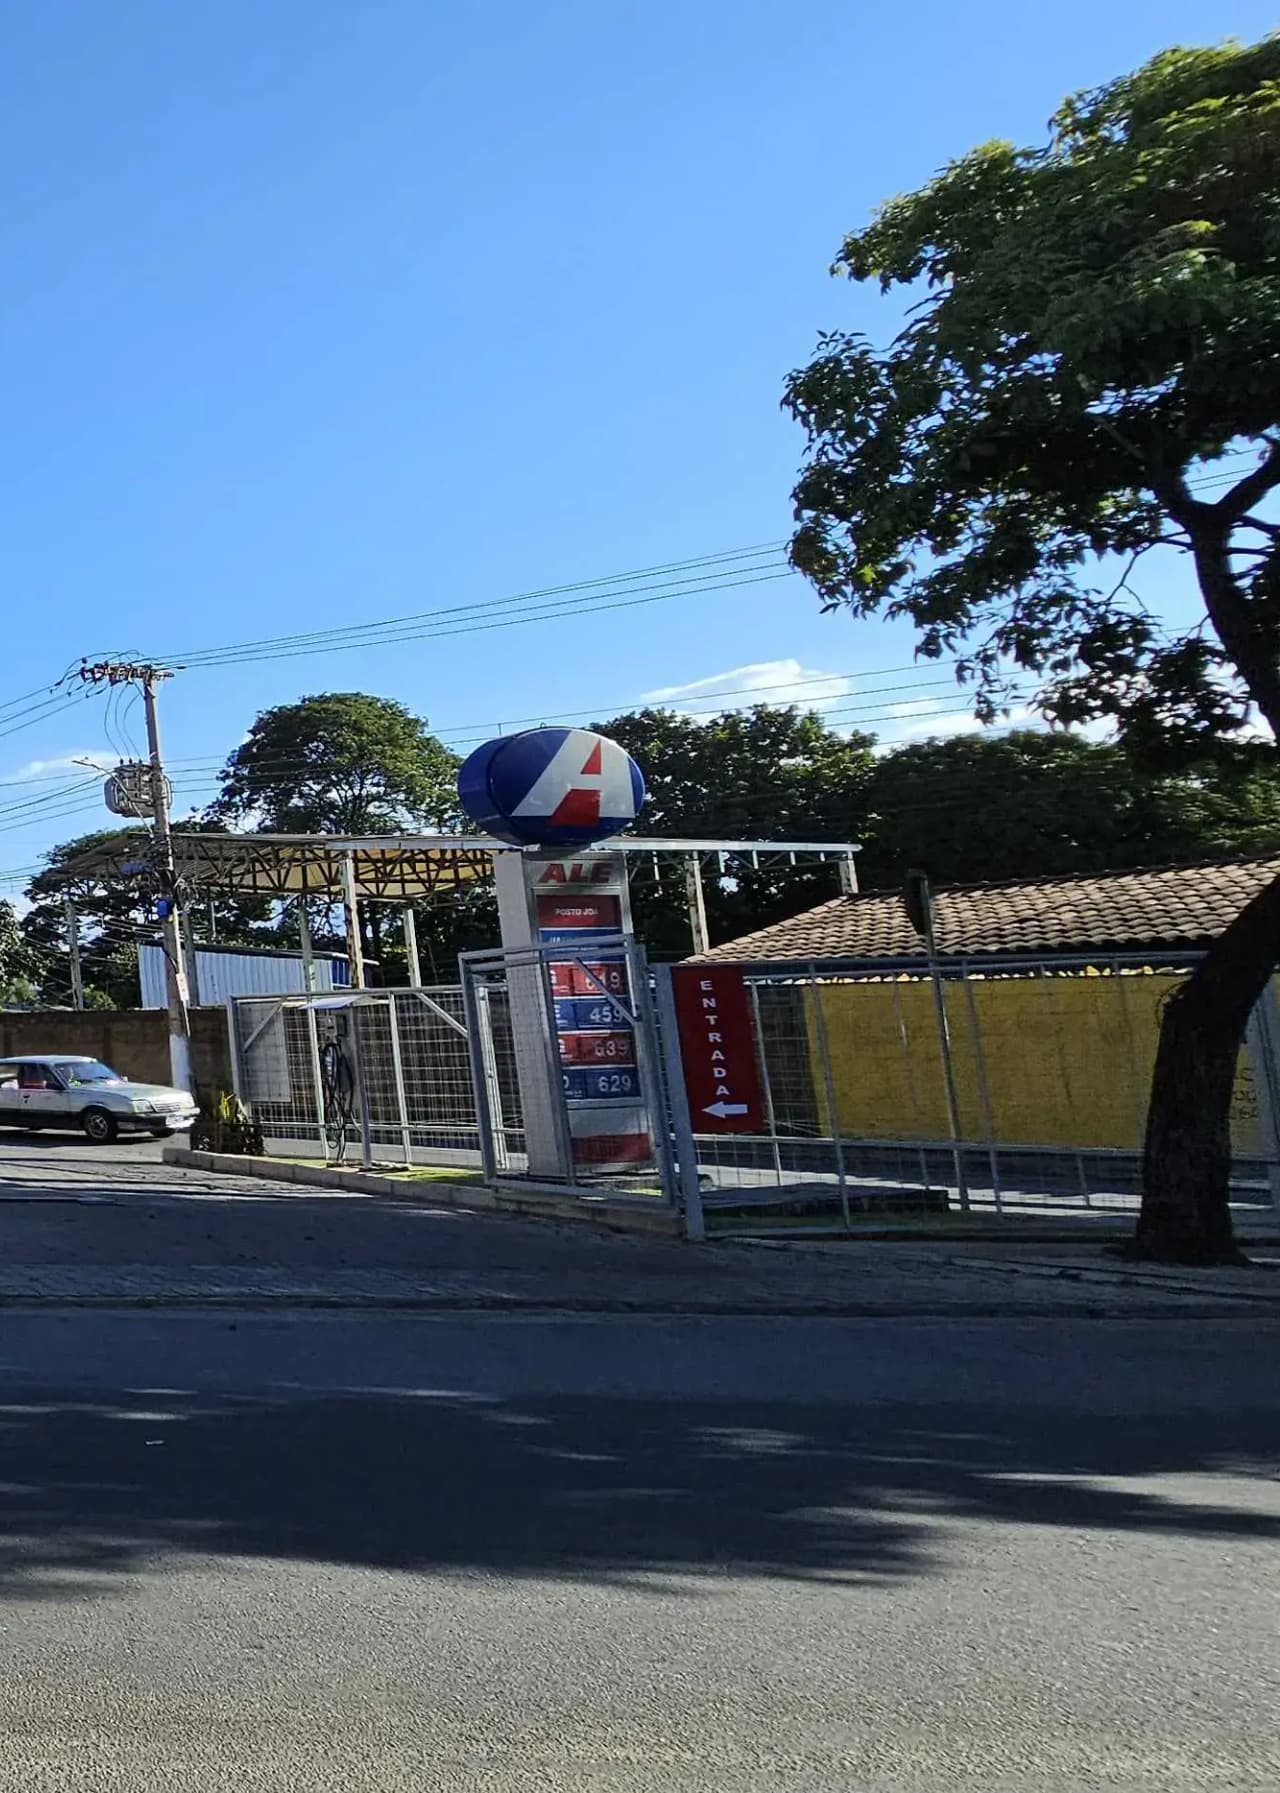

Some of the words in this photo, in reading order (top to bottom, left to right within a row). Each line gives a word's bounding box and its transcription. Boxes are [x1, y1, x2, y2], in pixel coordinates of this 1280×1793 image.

[537, 863, 614, 884] ALE
[589, 1006, 622, 1023] 459
[700, 980, 730, 1096] ENTRADA
[594, 1041, 628, 1056] 639
[598, 1075, 632, 1092] 629
